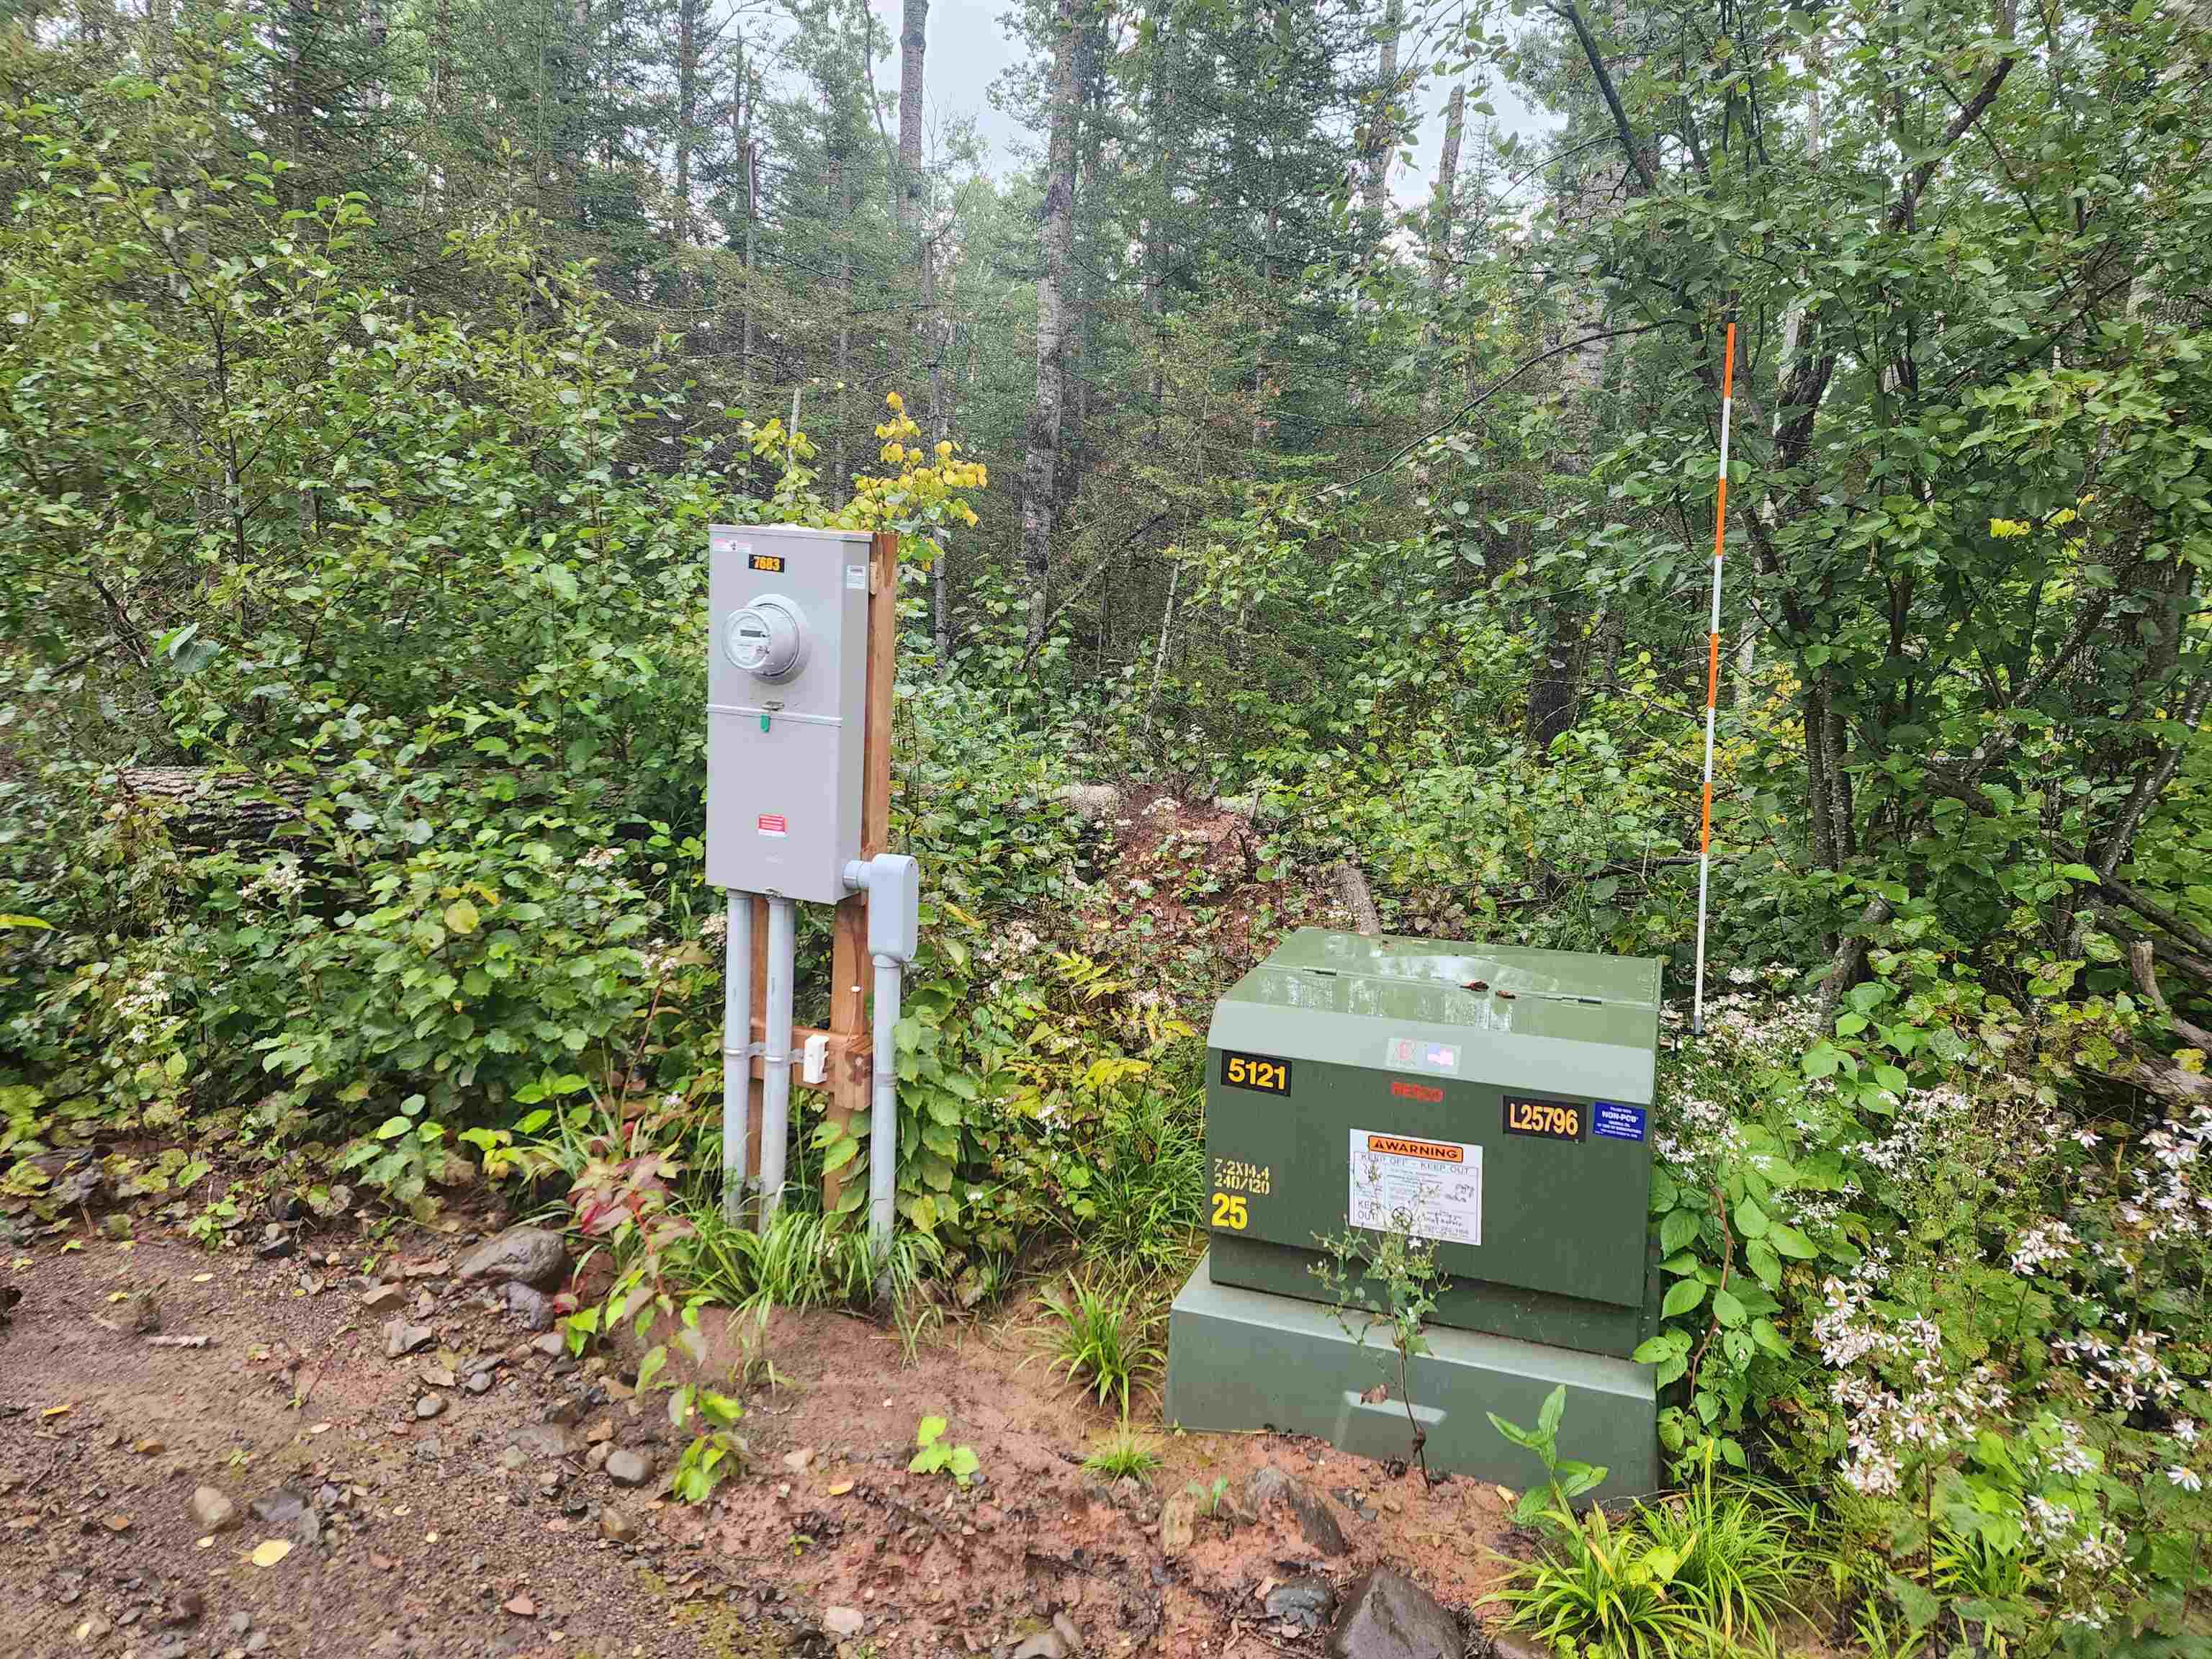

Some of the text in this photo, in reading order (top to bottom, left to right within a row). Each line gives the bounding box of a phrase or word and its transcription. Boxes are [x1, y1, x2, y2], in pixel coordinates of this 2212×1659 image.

[1228, 1057, 1285, 1090] 5121
[1509, 1102, 1579, 1136] L25796
[1386, 1140, 1458, 1159] WARNING
[1420, 1162, 1447, 1173] KEEP
[1450, 1166, 1470, 1175] OUT
[1211, 1192, 1248, 1230] 25
